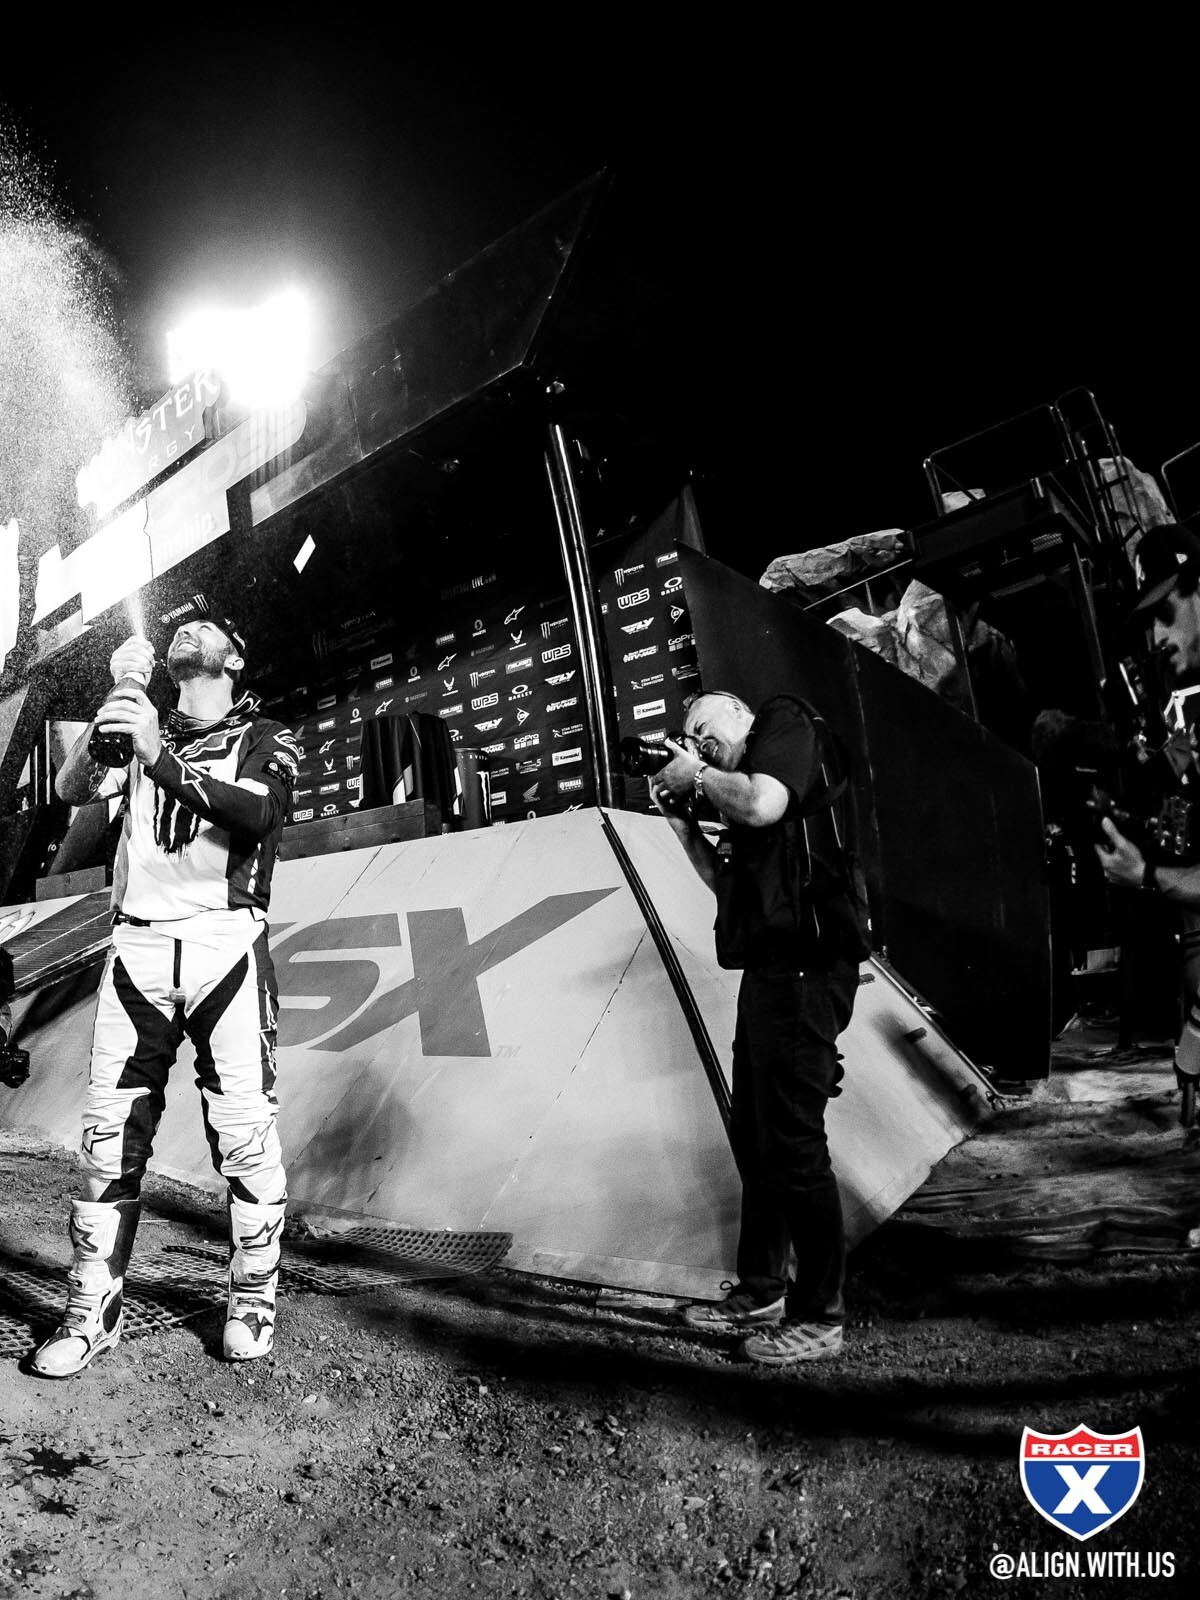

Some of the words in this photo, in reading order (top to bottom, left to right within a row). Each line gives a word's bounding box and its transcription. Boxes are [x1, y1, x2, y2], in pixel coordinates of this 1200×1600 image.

[617, 588, 650, 609] WPS
[167, 602, 195, 619] YAMAHA
[541, 645, 571, 663] WPS
[471, 692, 499, 711] WPS
[293, 808, 314, 822] WPS
